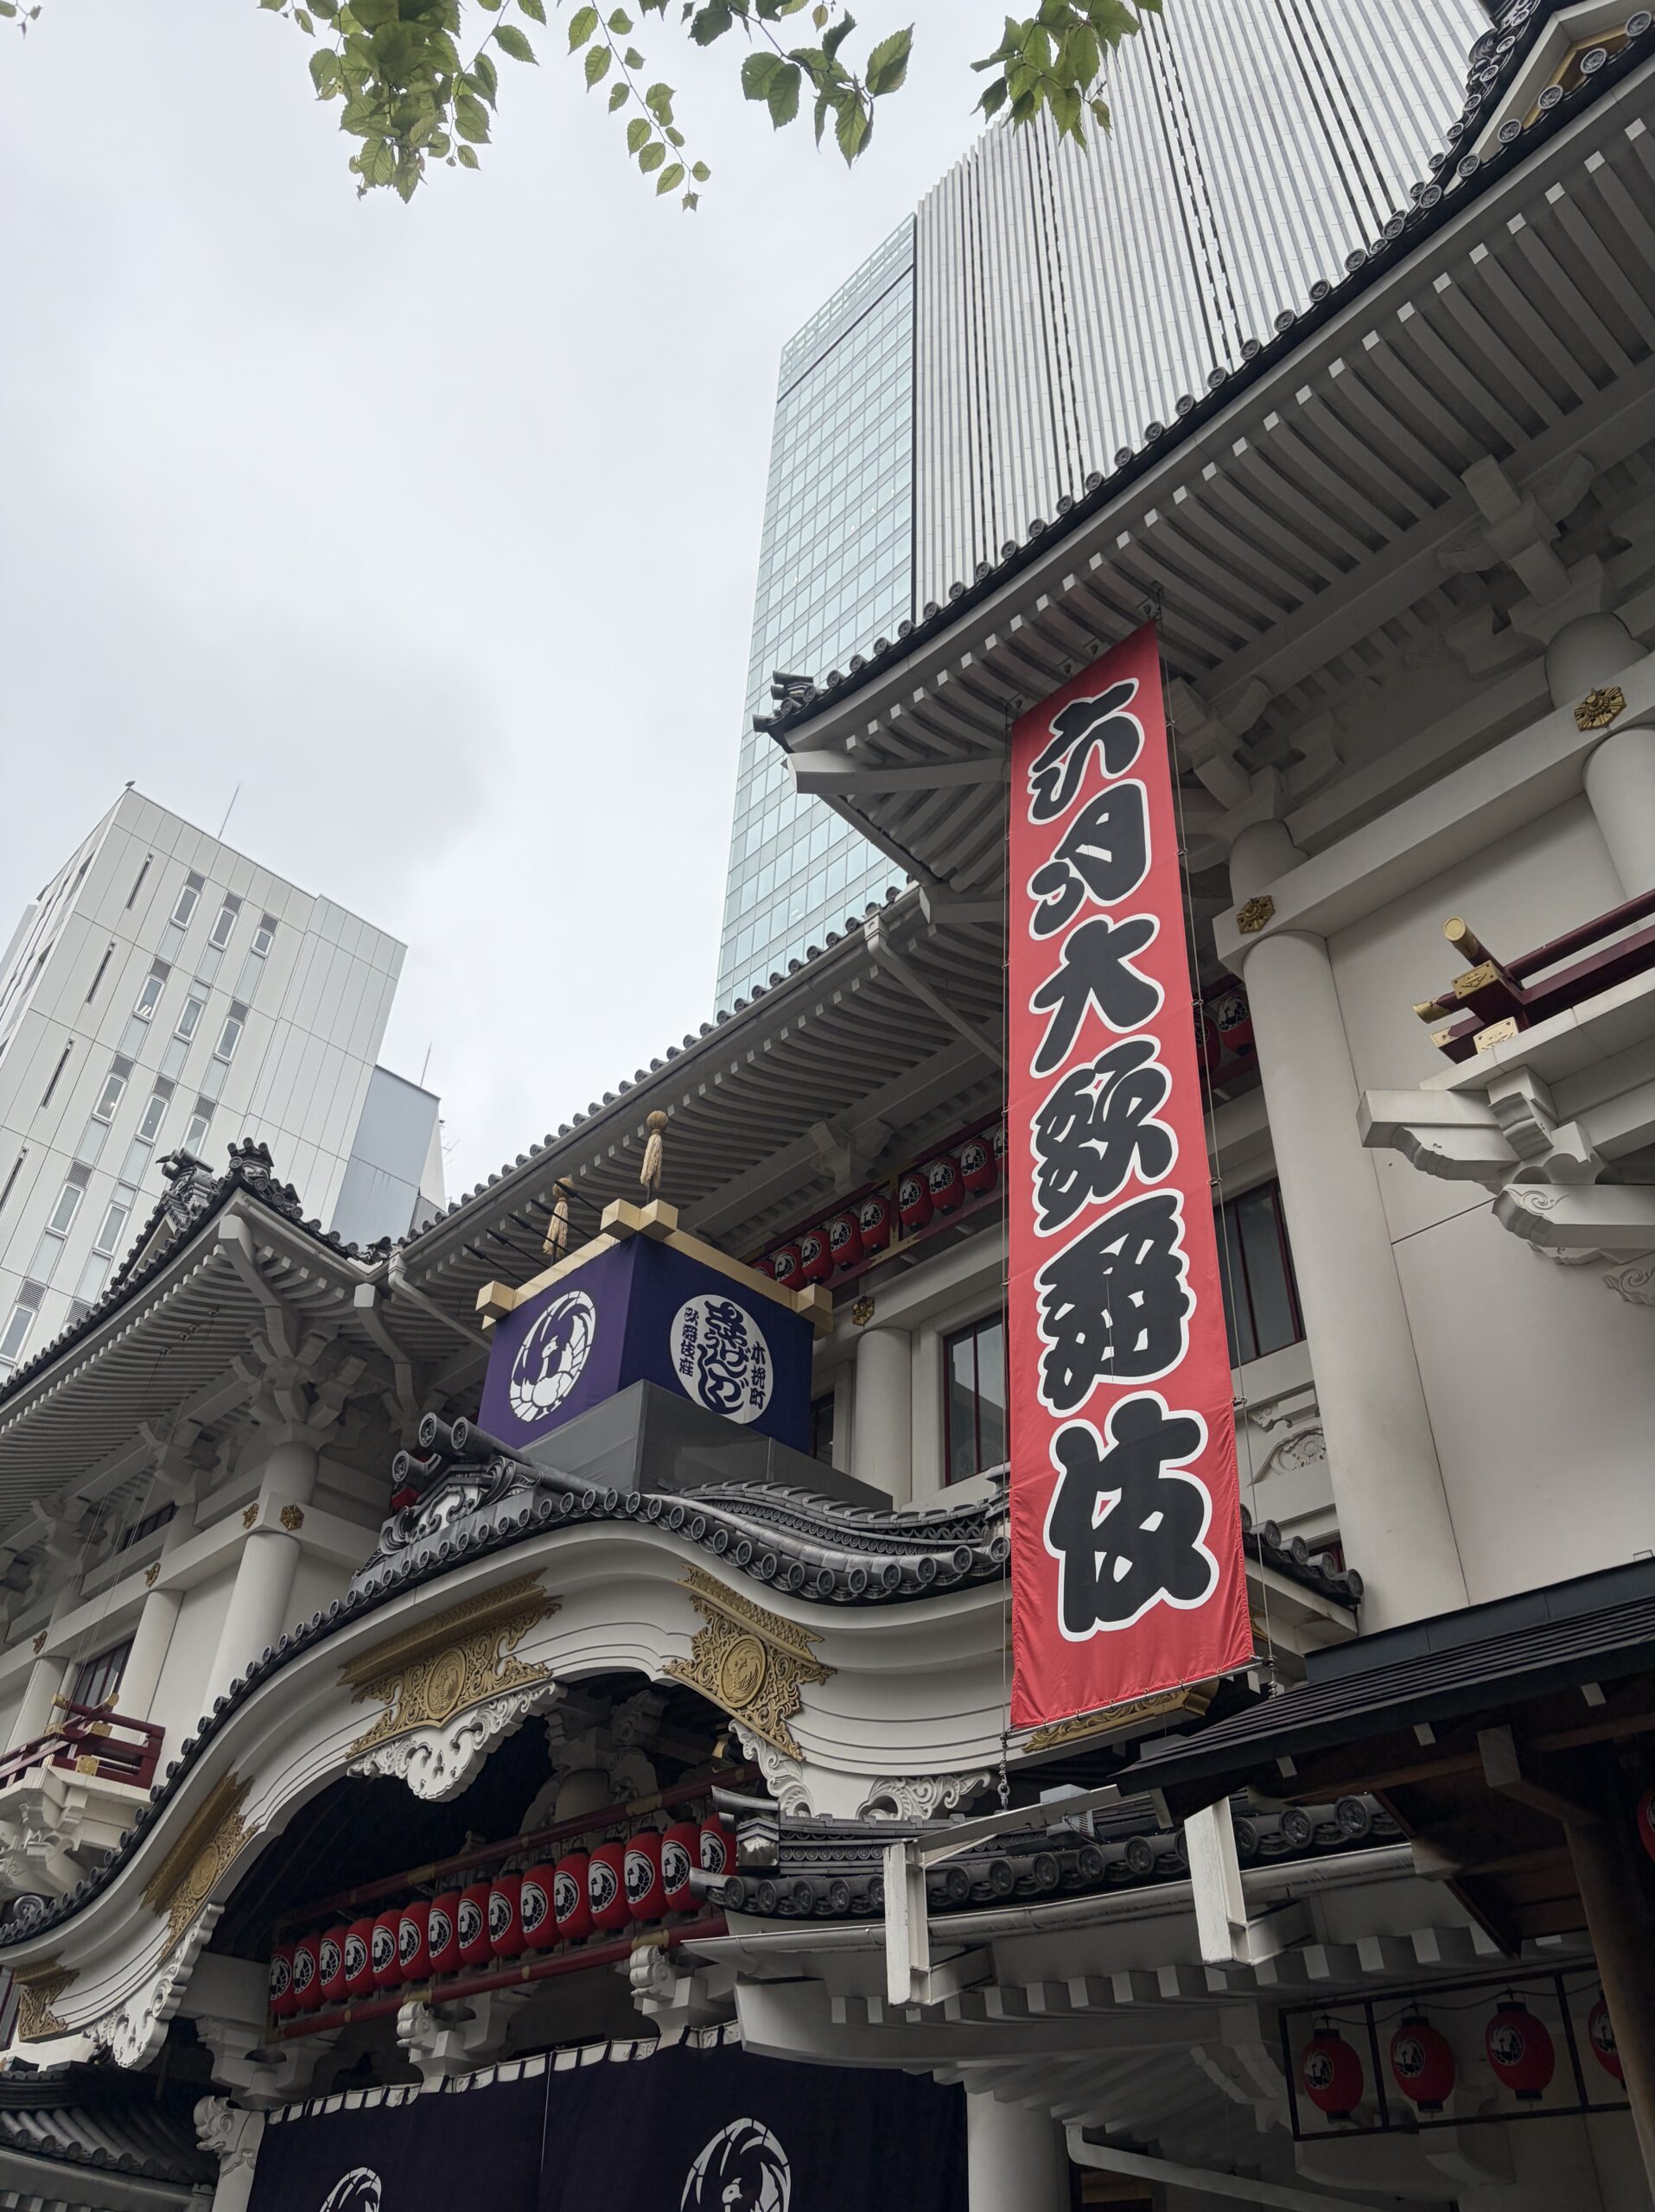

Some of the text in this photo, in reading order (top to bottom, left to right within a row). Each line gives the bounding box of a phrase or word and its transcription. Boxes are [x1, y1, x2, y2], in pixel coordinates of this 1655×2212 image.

[679, 1307, 699, 1377] 歌舞伎座
[749, 1341, 766, 1409] 木挽町
